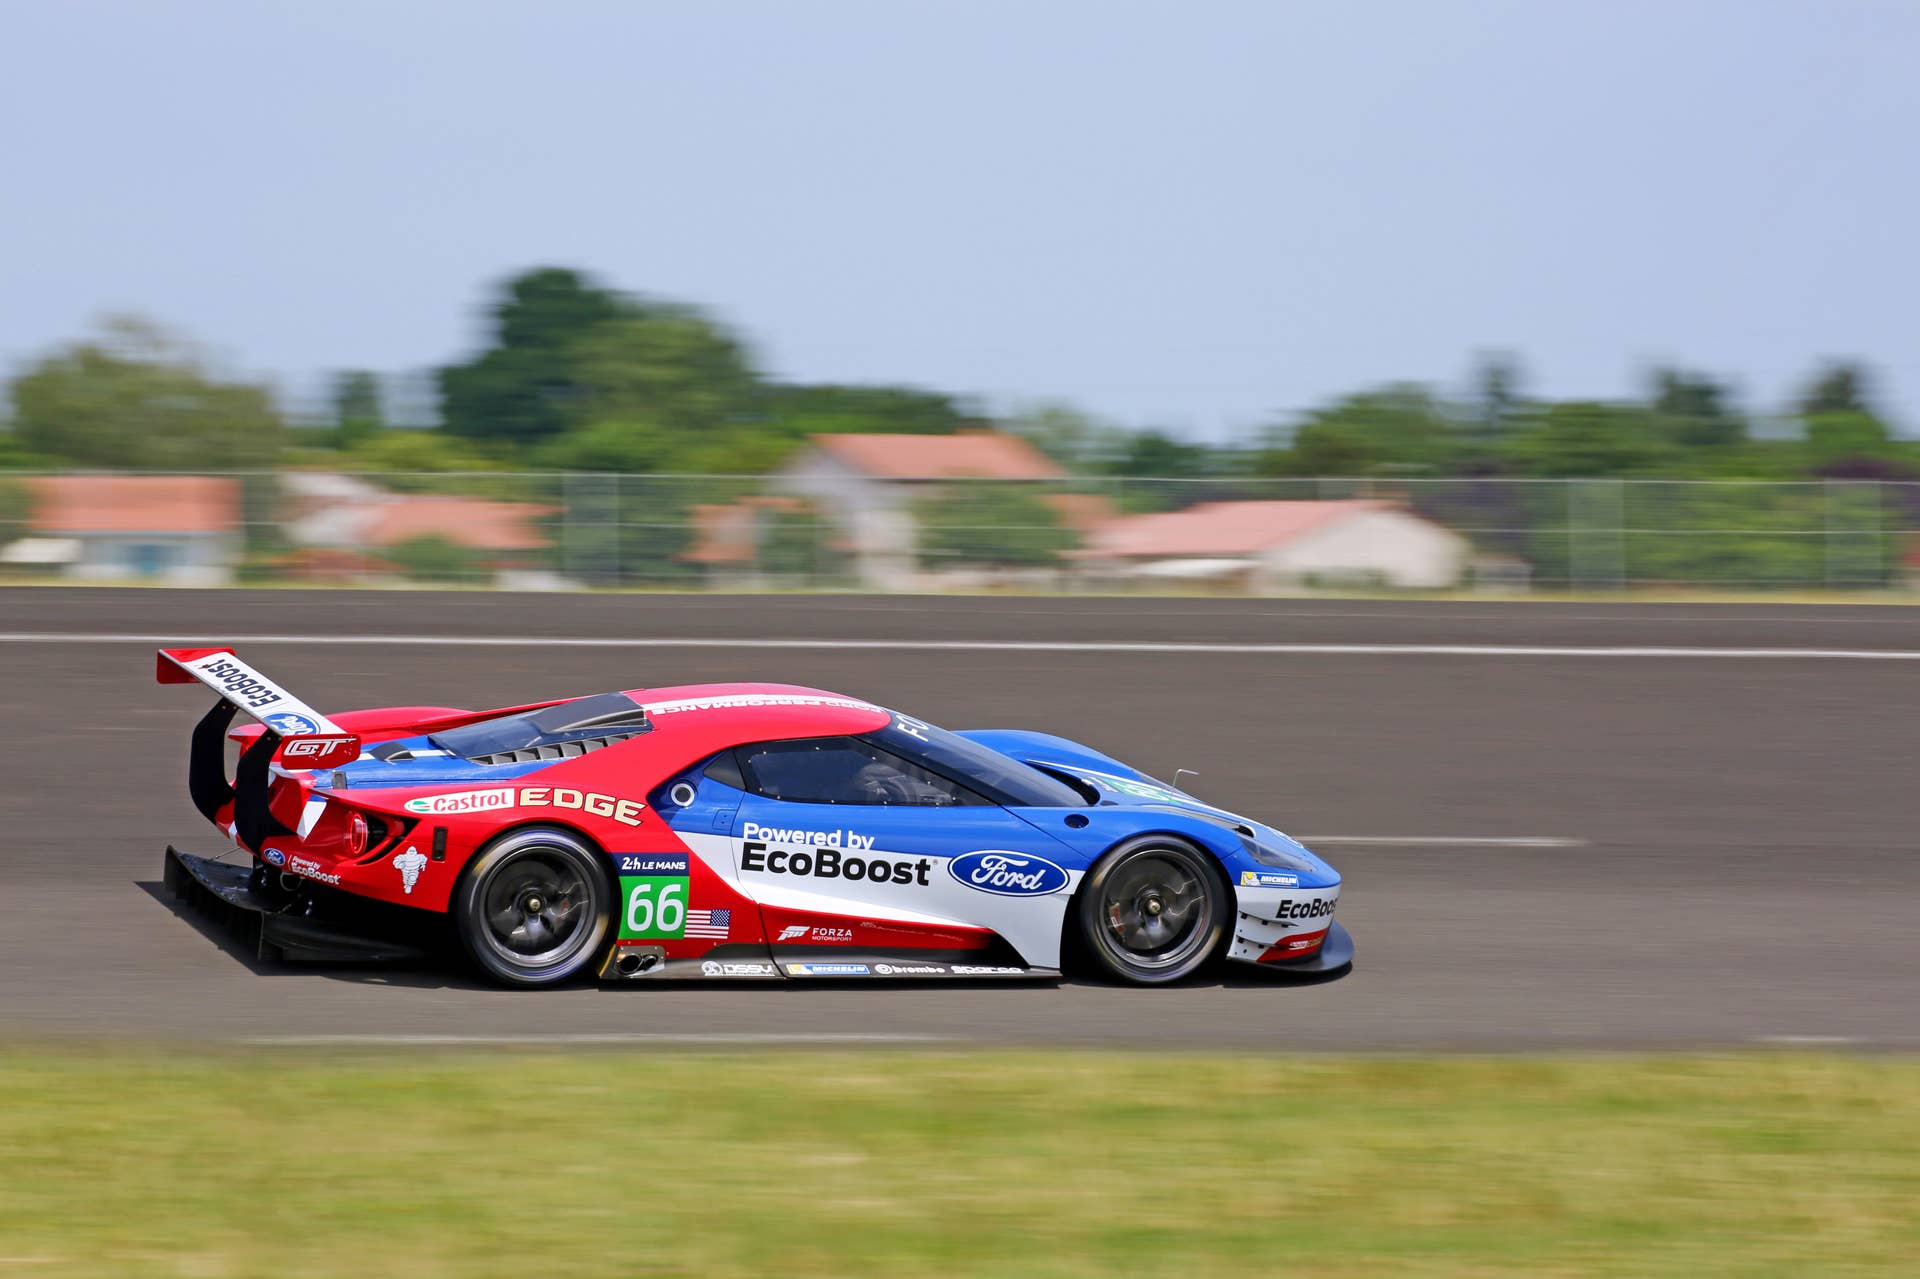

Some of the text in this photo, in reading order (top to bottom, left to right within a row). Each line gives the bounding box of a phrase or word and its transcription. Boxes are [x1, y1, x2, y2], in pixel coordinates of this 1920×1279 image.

[283, 737, 357, 757] GT
[433, 787, 647, 827] Castrol EDGE
[742, 822, 876, 850] Powered by
[291, 861, 341, 885] EcoBoost
[642, 861, 655, 870] LE
[655, 861, 686, 870] MANS
[741, 841, 932, 887] EcoBoost
[970, 855, 1043, 891] Ford
[1260, 875, 1297, 885] MICHELIN
[627, 884, 684, 932] 66
[811, 927, 852, 937] FORZA
[812, 965, 866, 973] MICHELIN
[892, 965, 946, 974] brembo
